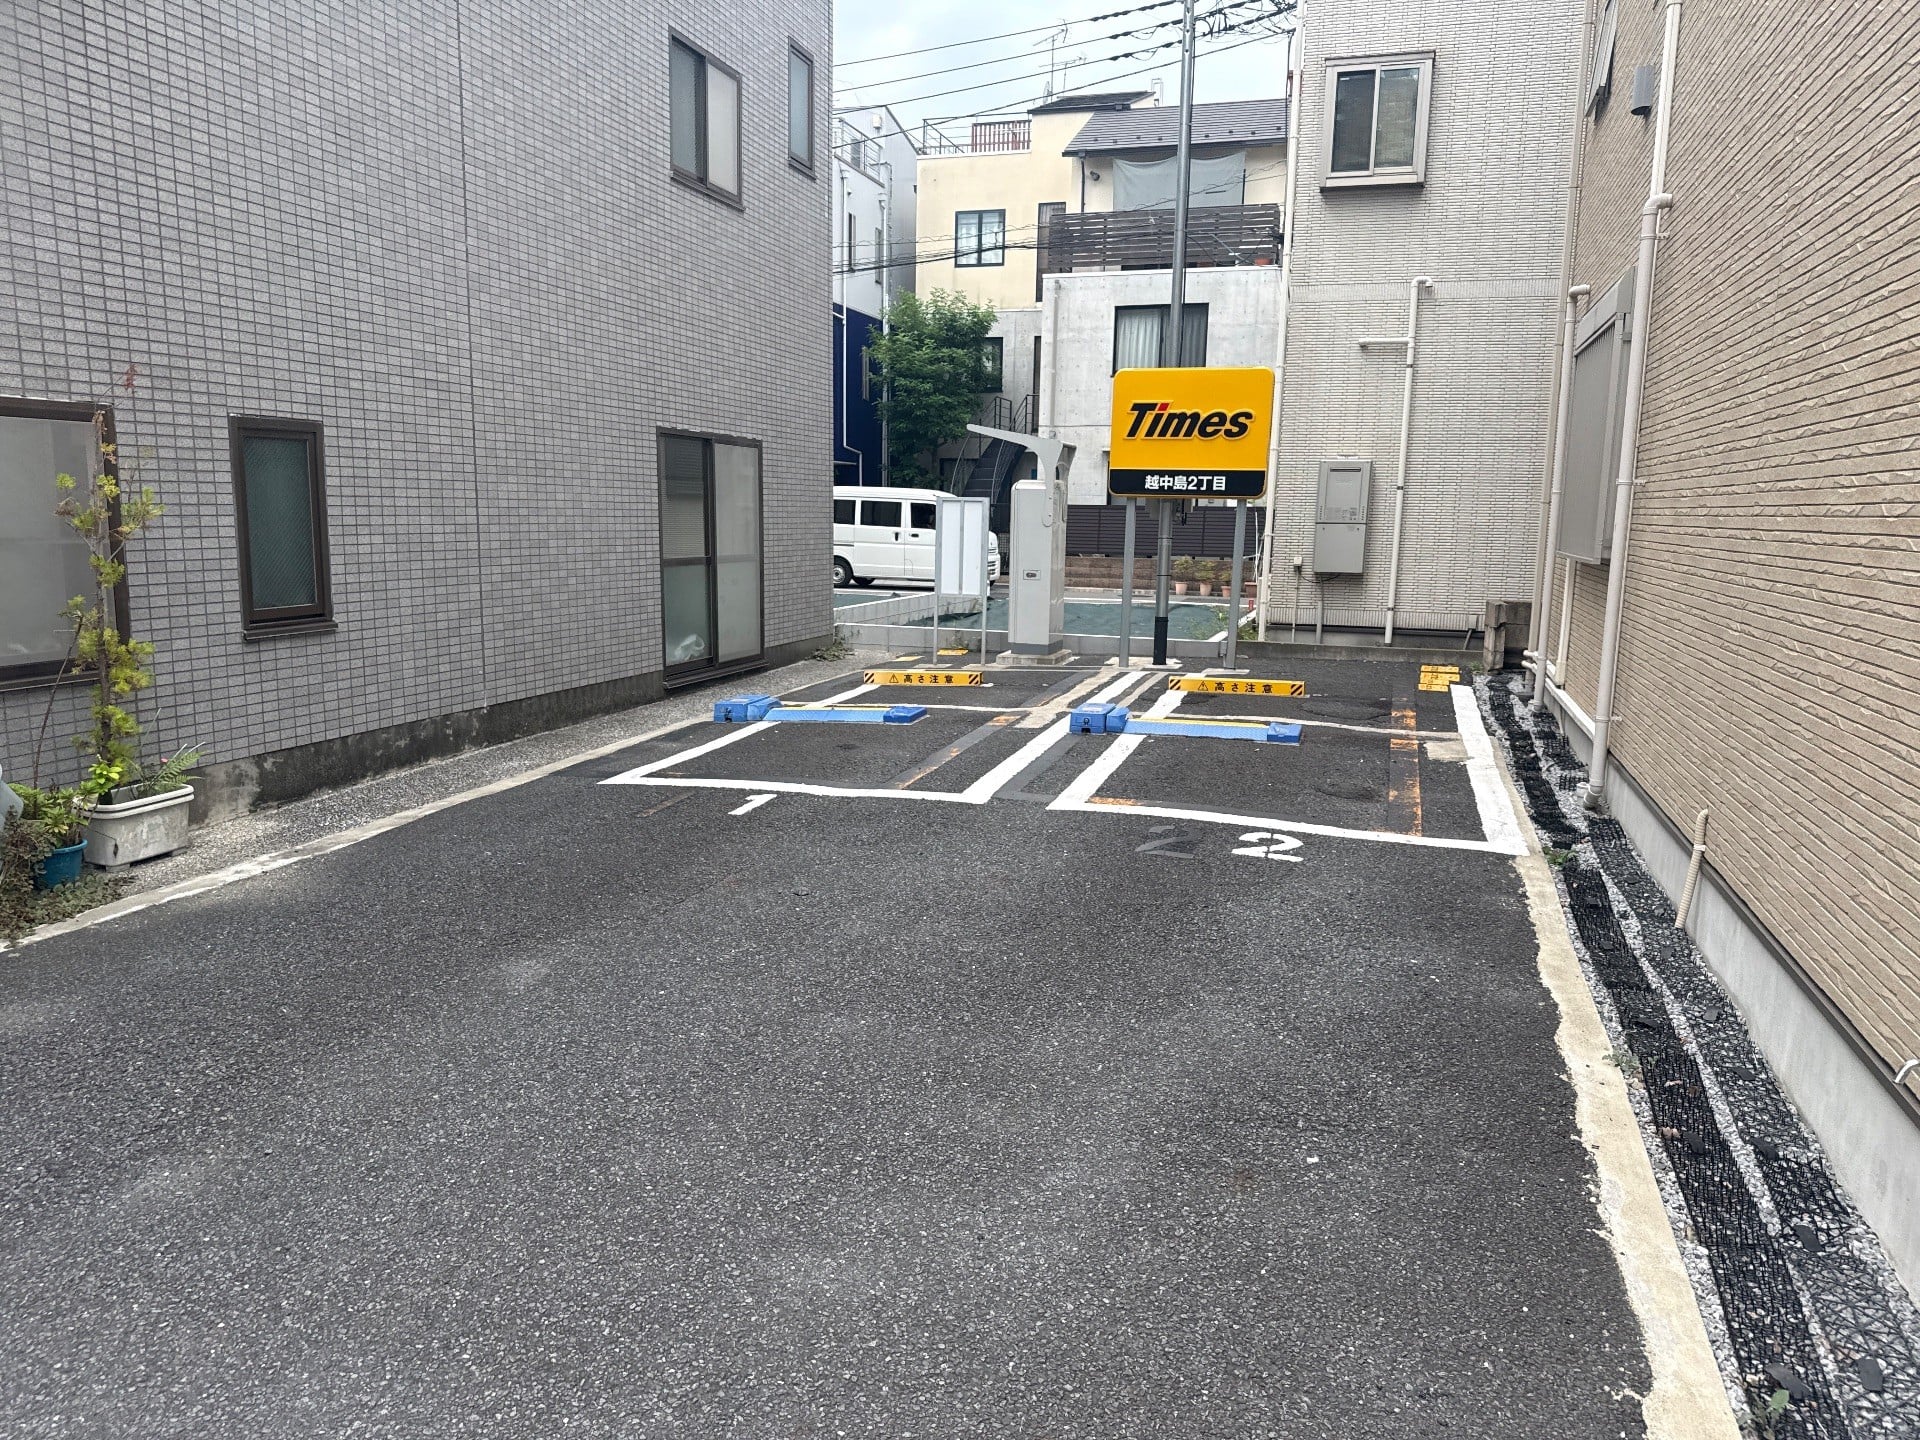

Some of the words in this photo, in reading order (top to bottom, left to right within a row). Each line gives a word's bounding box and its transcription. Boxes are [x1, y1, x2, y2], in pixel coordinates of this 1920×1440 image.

[1125, 401, 1254, 438] Times
[1145, 475, 1226, 491] 越中島2丁目
[903, 674, 955, 684] 高さ注意
[1214, 682, 1283, 694] 高さ注意
[728, 793, 777, 815] 1
[1231, 831, 1304, 862] 2
